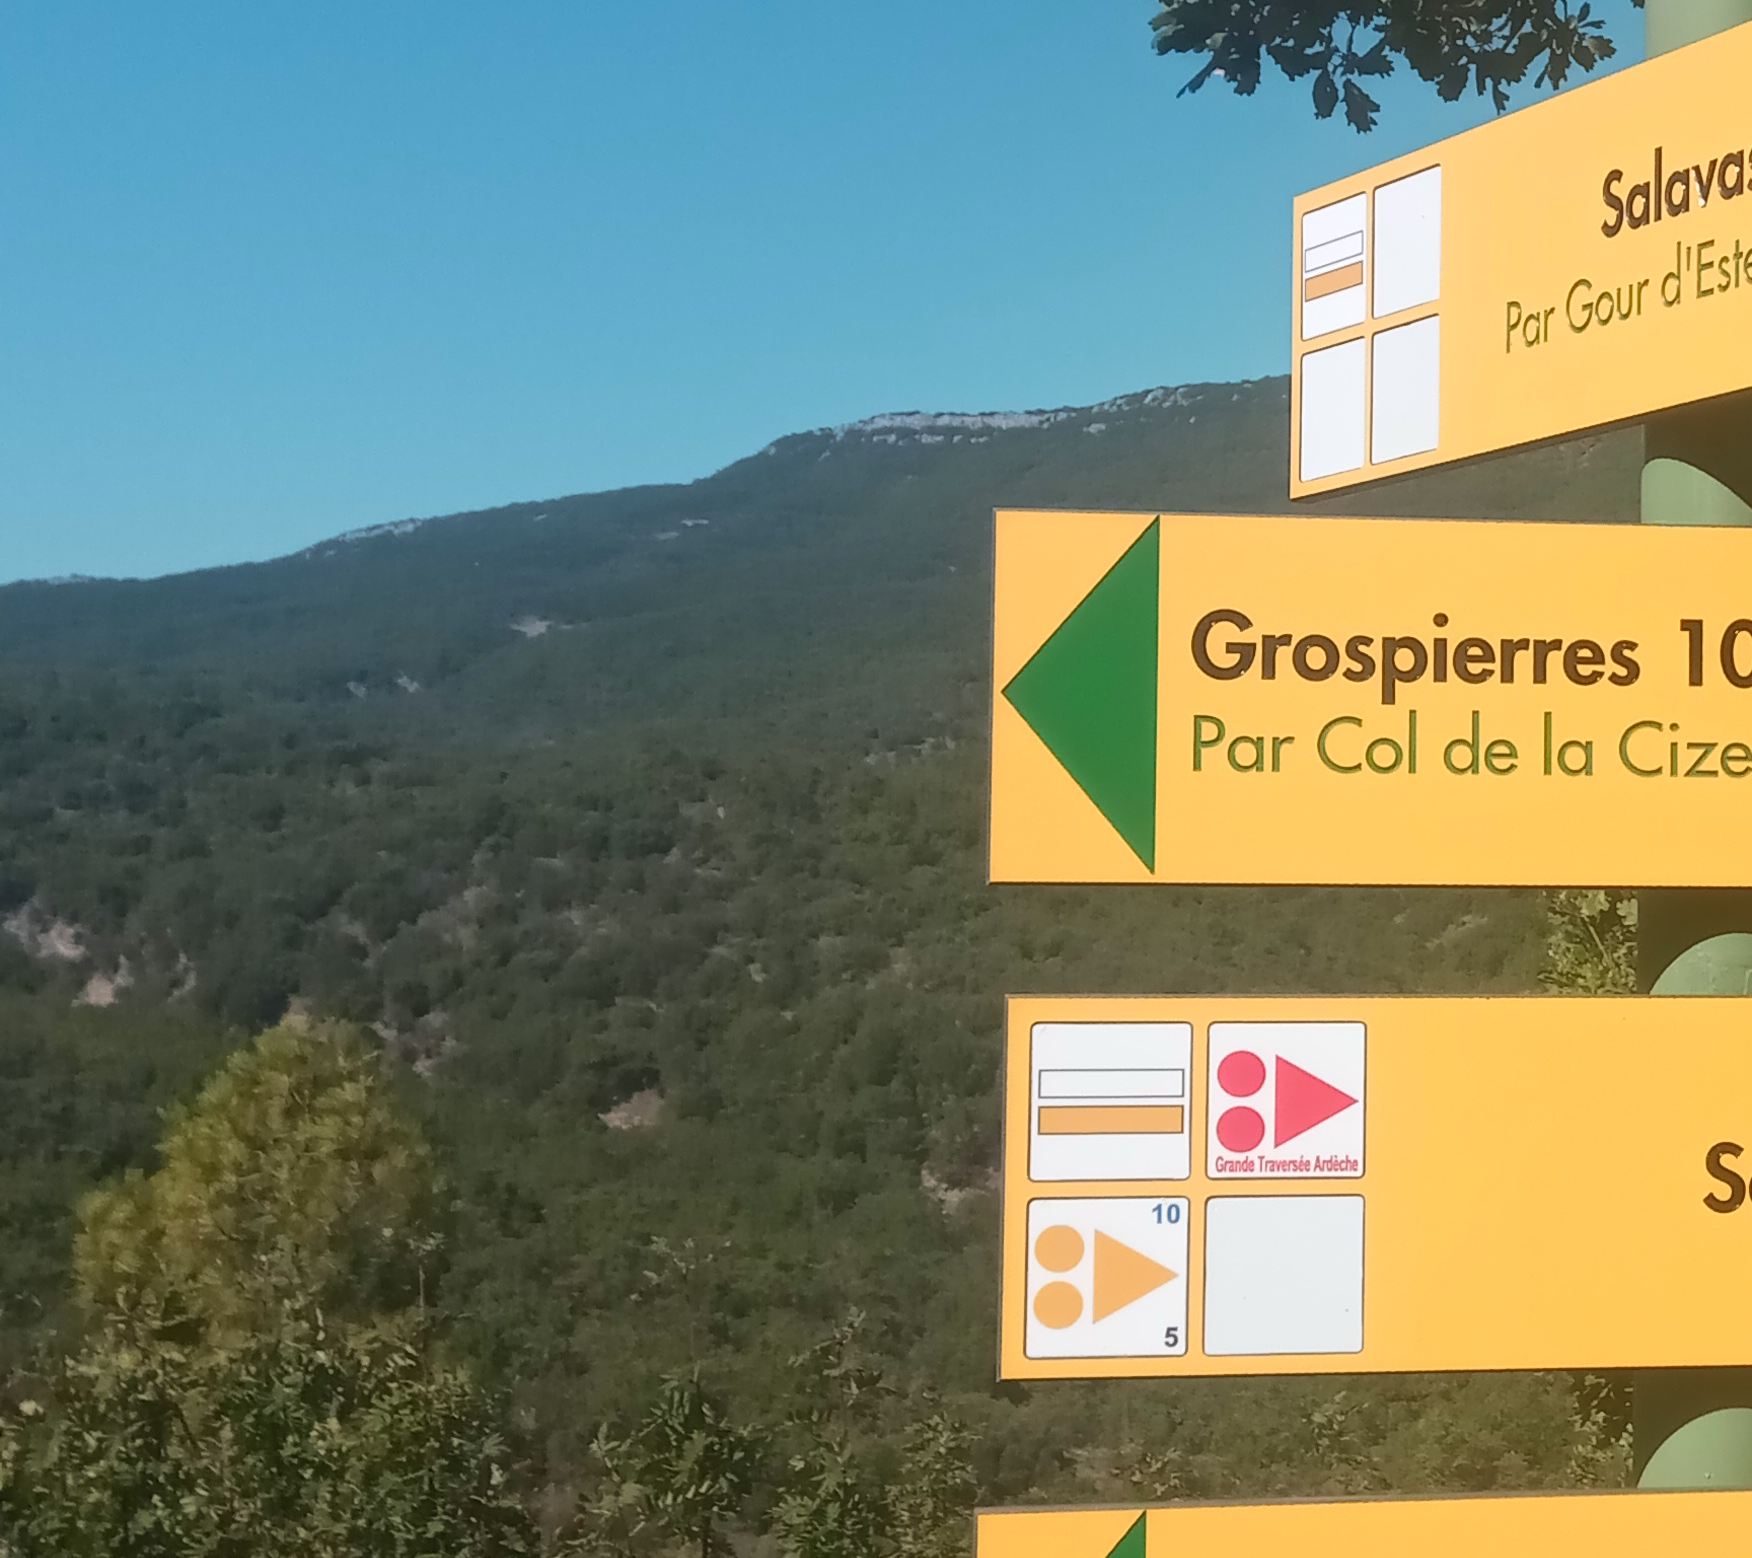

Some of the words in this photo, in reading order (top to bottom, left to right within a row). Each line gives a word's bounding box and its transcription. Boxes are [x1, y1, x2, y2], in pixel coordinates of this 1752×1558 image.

[1506, 300, 1555, 354] Par
[1566, 277, 1650, 334] Gour
[1191, 609, 1641, 705] Grospierres
[1192, 715, 1295, 772] Par
[1317, 710, 1418, 775] Col
[1443, 710, 1519, 776] de
[1543, 711, 1594, 777] la
[1215, 1155, 1255, 1173] Grande
[1258, 1155, 1311, 1172] Traversée
[1313, 1154, 1359, 1172] Ardèche
[1152, 1204, 1181, 1224] 10
[1164, 1327, 1179, 1348] 5
